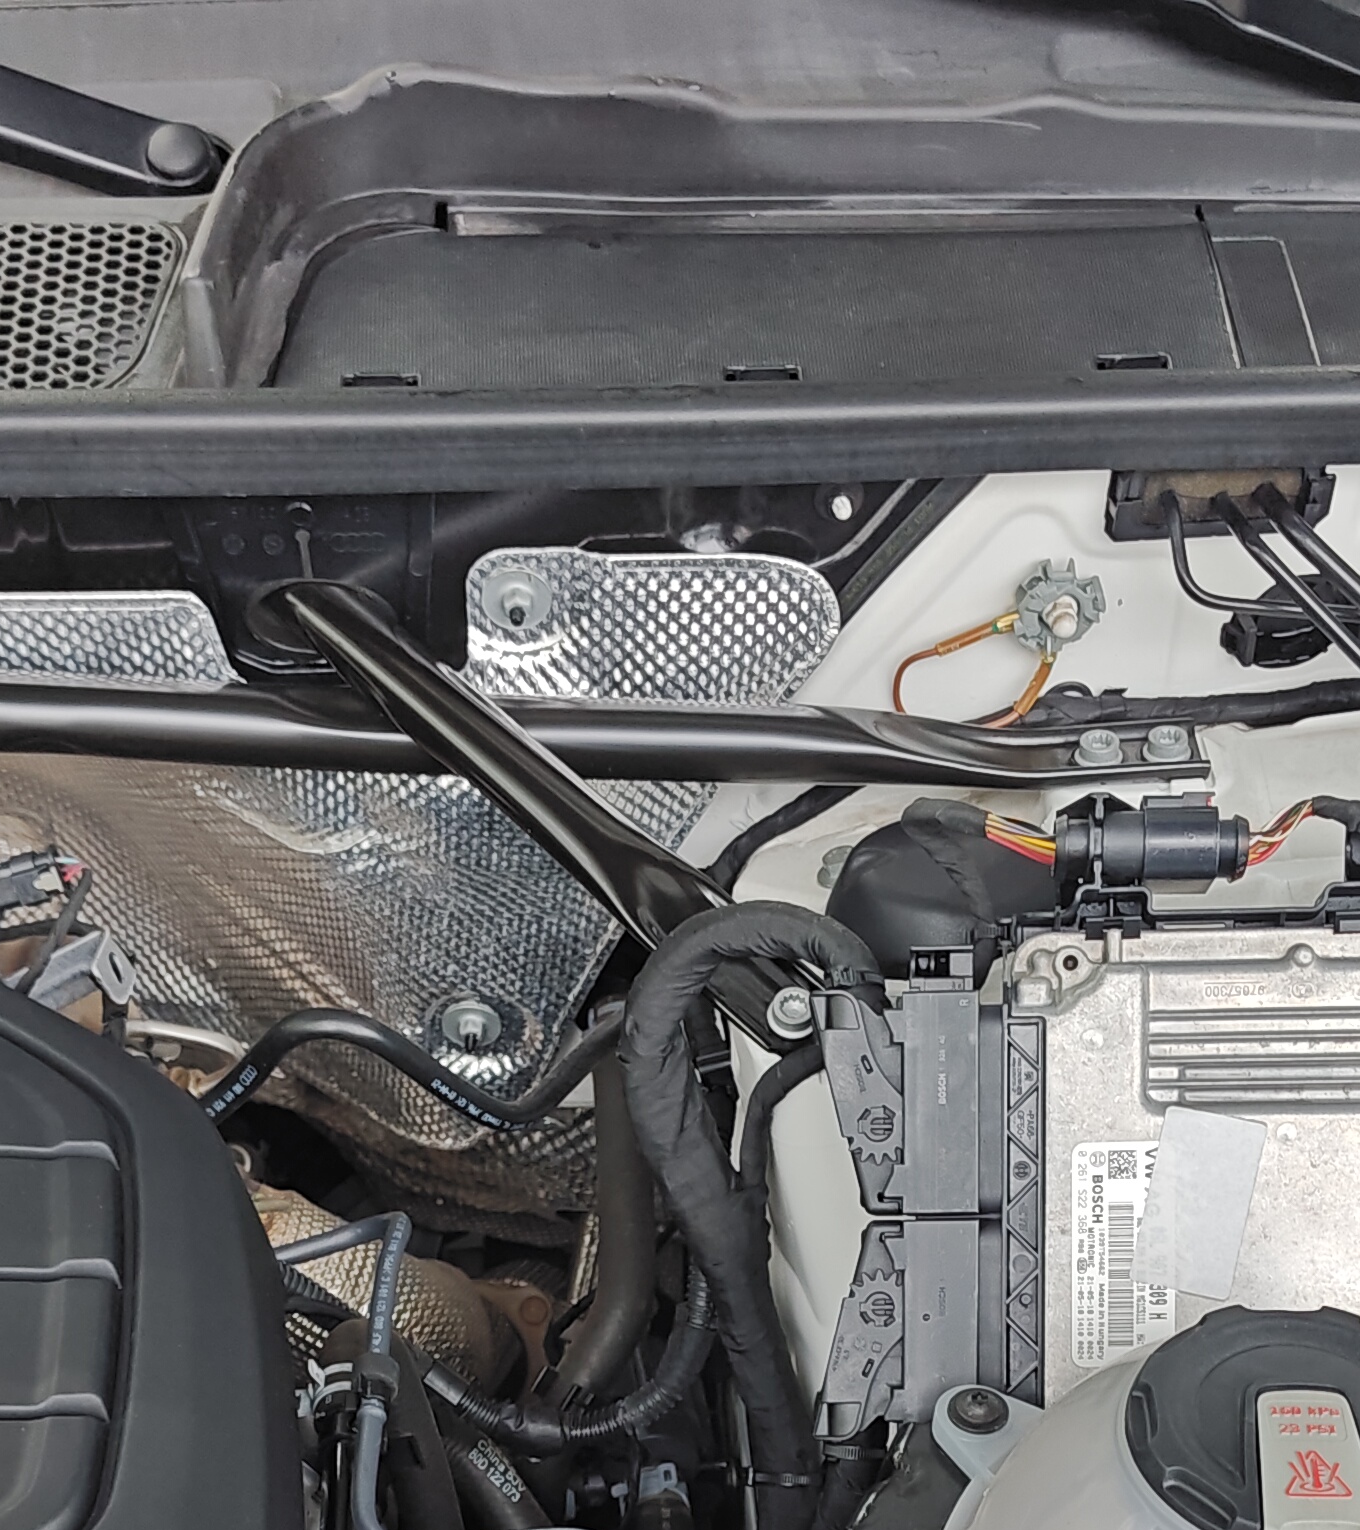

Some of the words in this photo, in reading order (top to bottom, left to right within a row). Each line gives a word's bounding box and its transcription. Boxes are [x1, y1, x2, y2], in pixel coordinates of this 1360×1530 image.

[937, 1072, 946, 1104] BOSCH
[1078, 1163, 1086, 1181] 261
[1078, 1189, 1086, 1208] S22
[1092, 1174, 1103, 1223] BOSCH
[1078, 1214, 1086, 1234] 368
[1148, 1283, 1167, 1305] 309
[1098, 1310, 1104, 1319] in
[1306, 1423, 1336, 1435] PSI
[484, 1465, 506, 1488] 122
